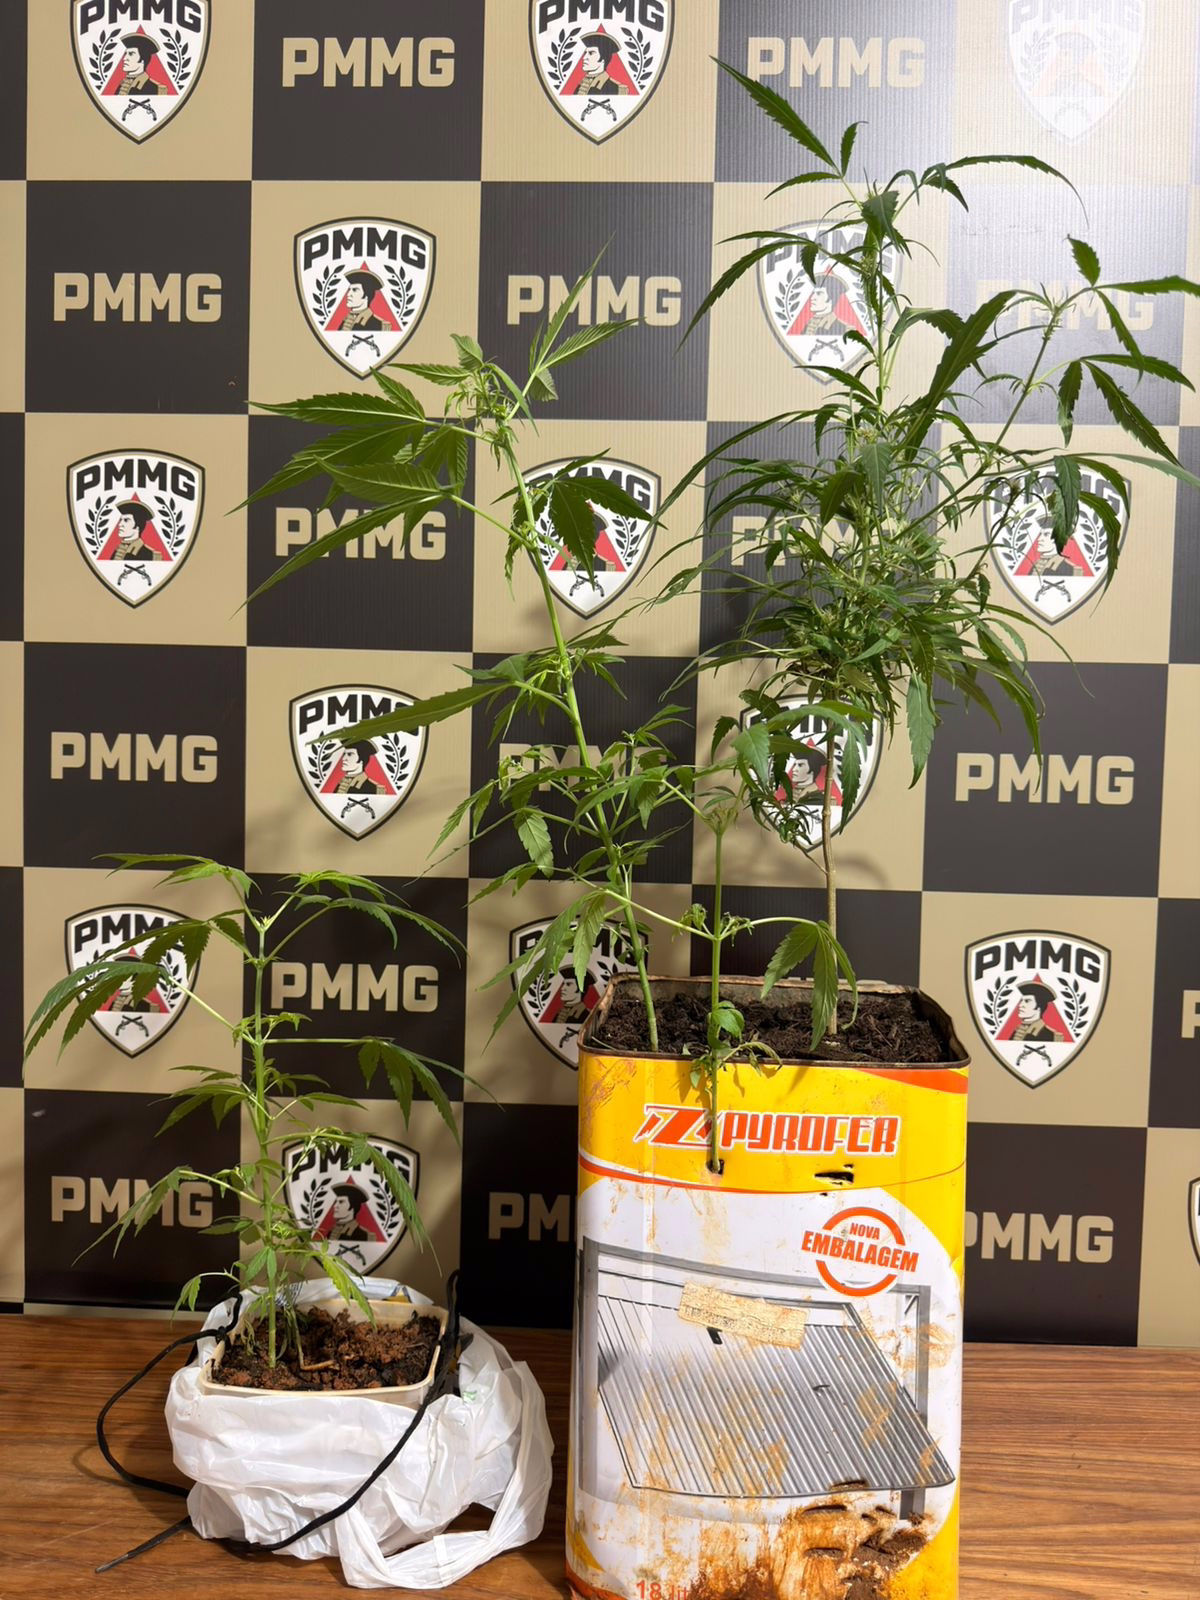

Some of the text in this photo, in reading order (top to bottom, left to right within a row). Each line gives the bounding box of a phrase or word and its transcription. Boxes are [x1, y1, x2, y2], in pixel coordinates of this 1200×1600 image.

[80, 0, 202, 35] PMMG
[539, 0, 664, 34] PMMG
[282, 37, 455, 88] PMMG
[747, 37, 925, 88] PMMG
[303, 227, 426, 270] PMMG
[54, 273, 222, 322] PMMG
[507, 275, 682, 326] PMMG
[76, 460, 196, 501] PMMG
[300, 694, 419, 736] PMM
[51, 732, 218, 783] PMMG
[955, 752, 1134, 805] PMMG
[75, 913, 190, 953] PMM
[975, 940, 1100, 982] PMMG
[271, 962, 438, 1012] PMMG
[488, 1192, 571, 1242] PM
[849, 1222, 880, 1240] NOVA
[802, 1230, 919, 1272] EMBALAGEM
[636, 1579, 661, 1600] 18
